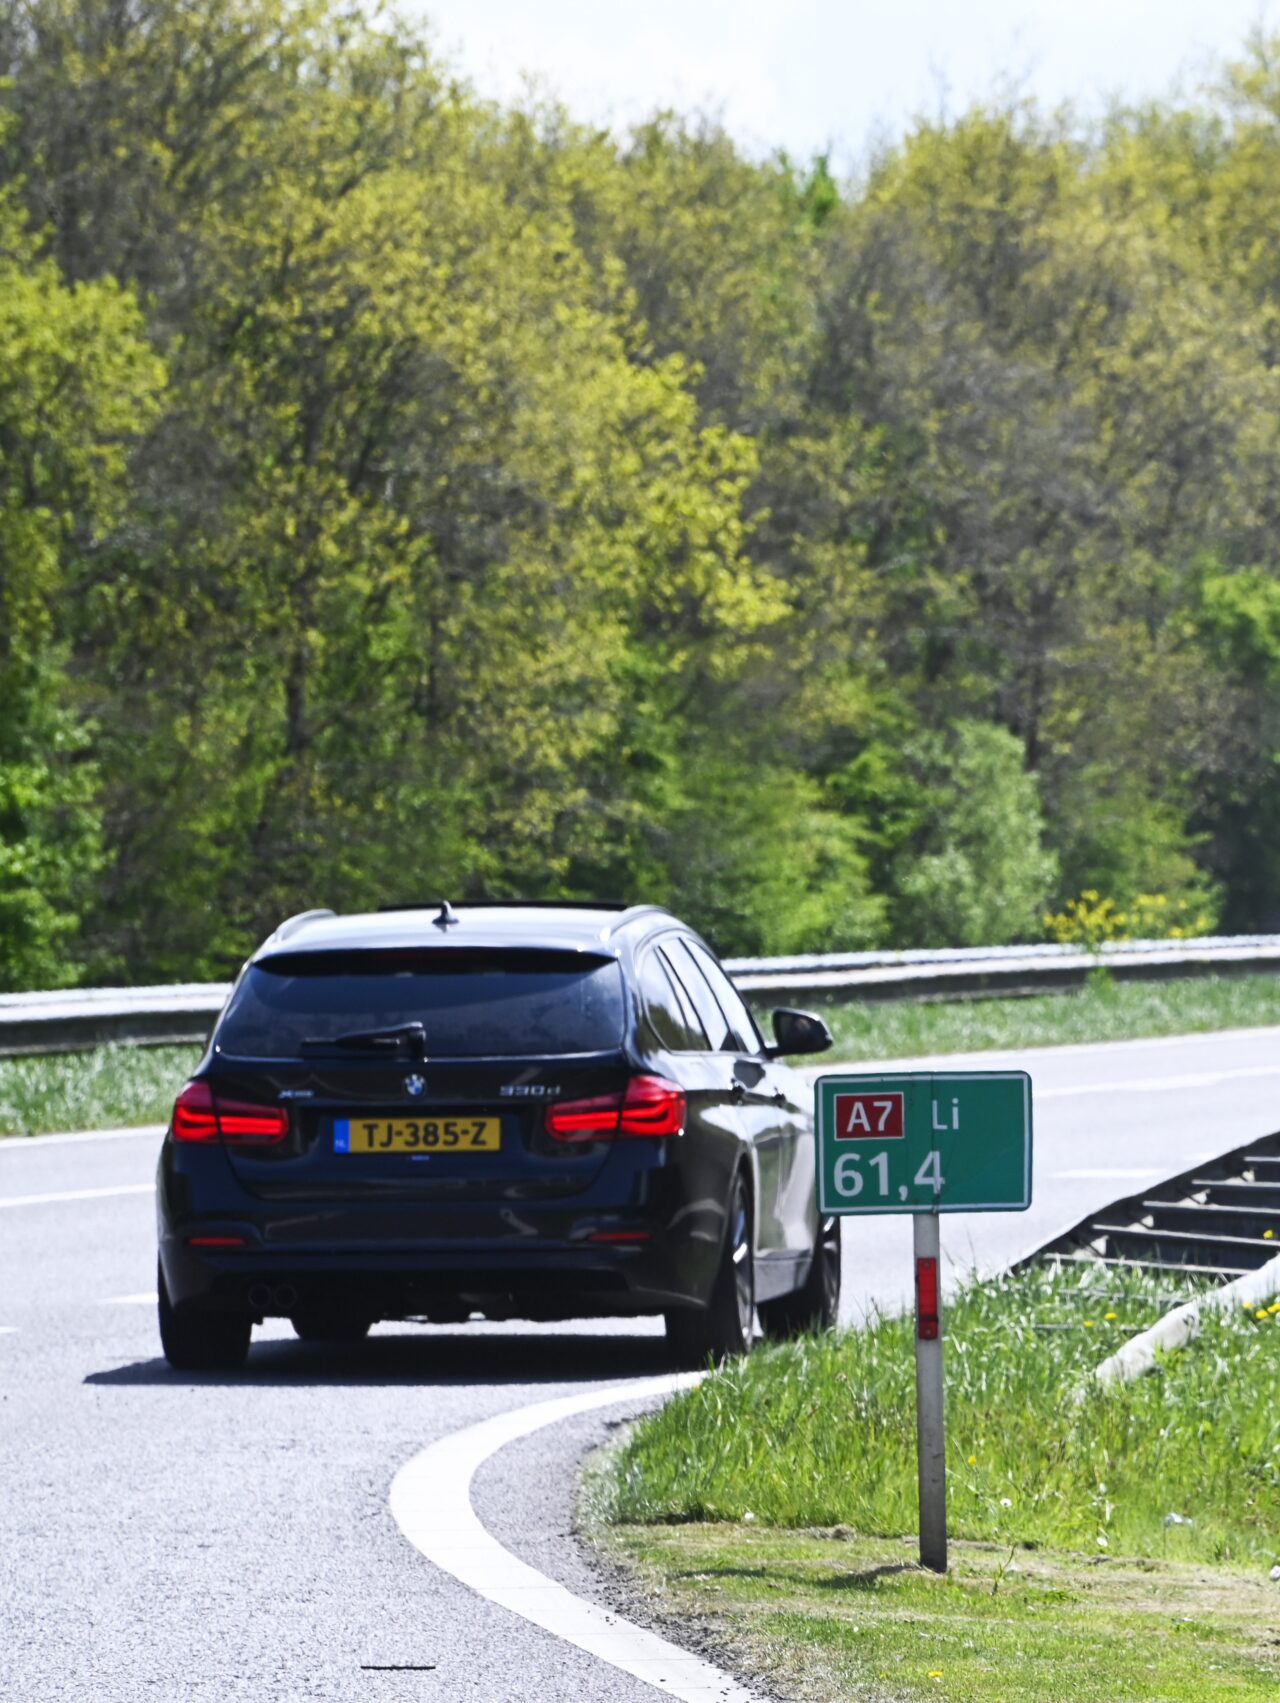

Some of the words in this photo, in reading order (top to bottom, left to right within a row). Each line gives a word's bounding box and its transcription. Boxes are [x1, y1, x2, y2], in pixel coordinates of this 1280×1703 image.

[847, 1100, 893, 1132] A7
[932, 1098, 960, 1130] Li
[362, 1122, 487, 1148] TJ-385-Z
[833, 1151, 946, 1201] 61,4
